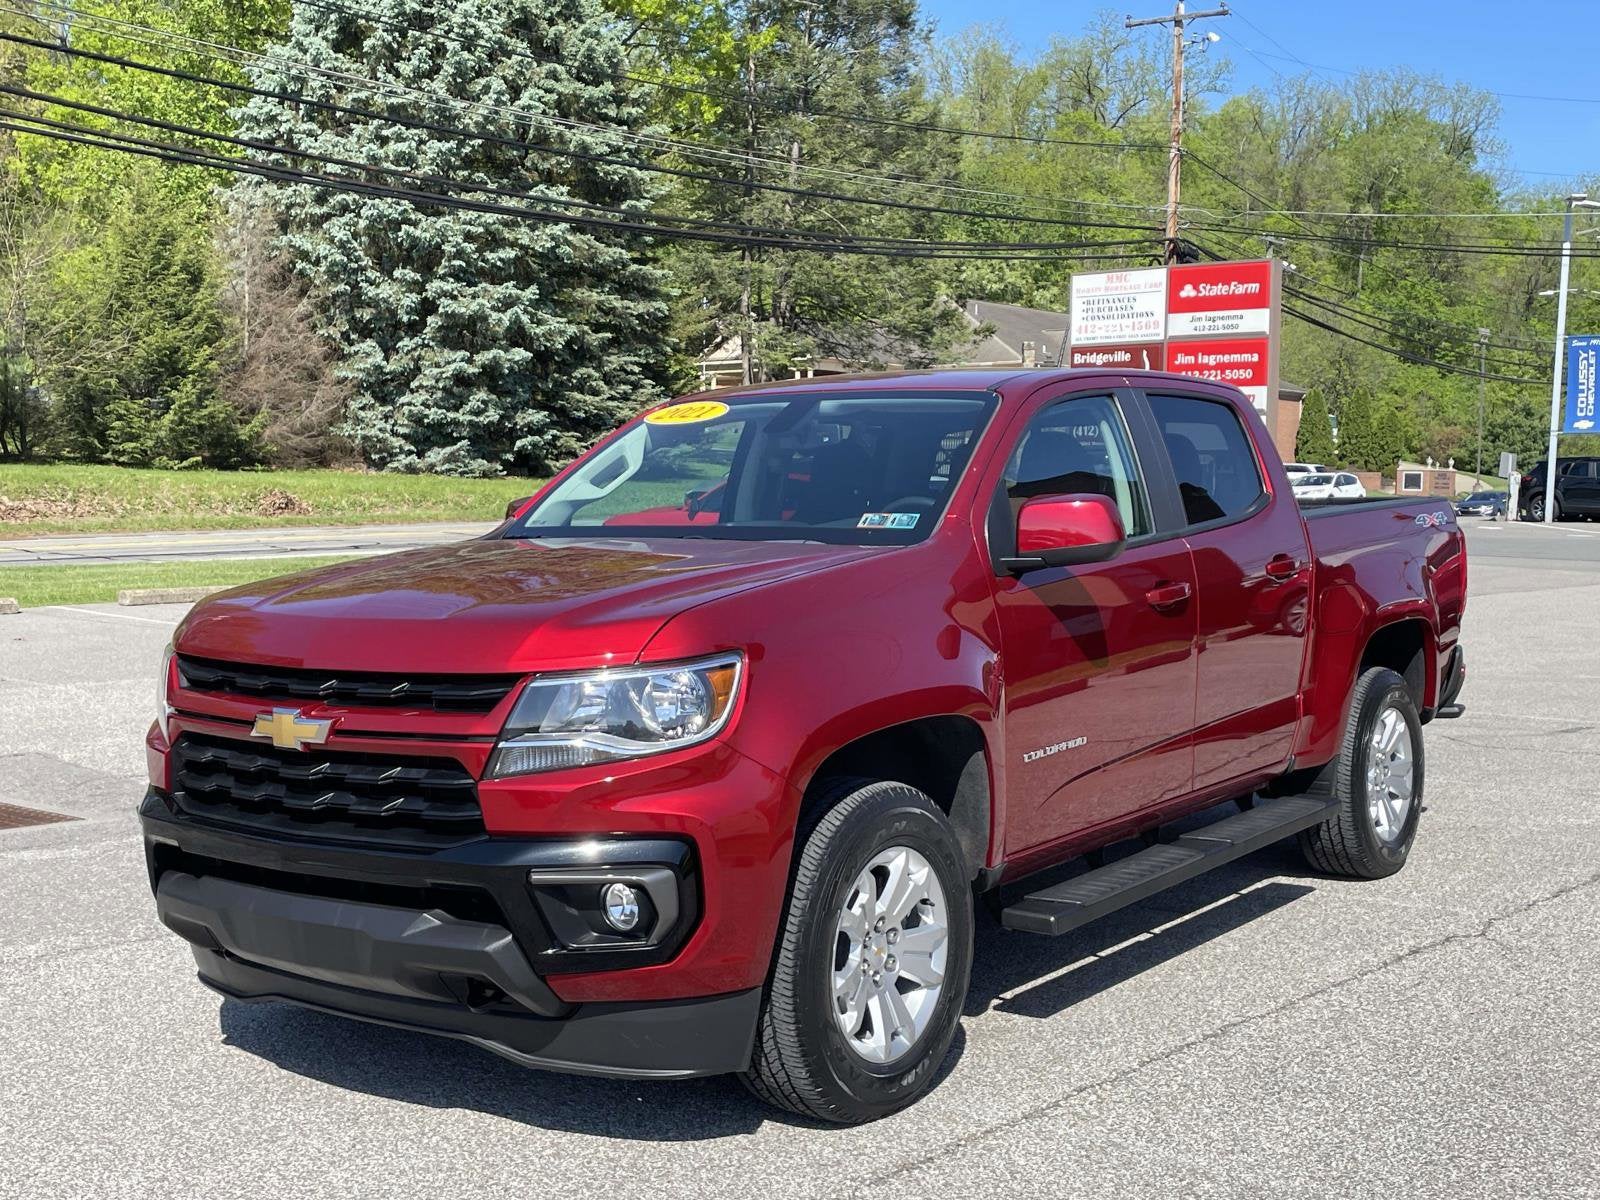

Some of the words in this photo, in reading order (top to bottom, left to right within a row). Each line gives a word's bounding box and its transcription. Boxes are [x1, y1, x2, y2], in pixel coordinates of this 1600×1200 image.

[1190, 315, 1203, 323] Jim
[1193, 323, 1240, 332] 412-221-5050
[1073, 350, 1132, 365] Bridgeville
[1174, 353, 1195, 365] Jim
[1198, 352, 1259, 366] Iagnemma
[1577, 350, 1588, 417] COLUSSY
[1586, 348, 1596, 417] CHEVROLET
[652, 405, 719, 420] 2021
[1072, 425, 1099, 439] (412)
[1023, 736, 1088, 763] COLORADO
